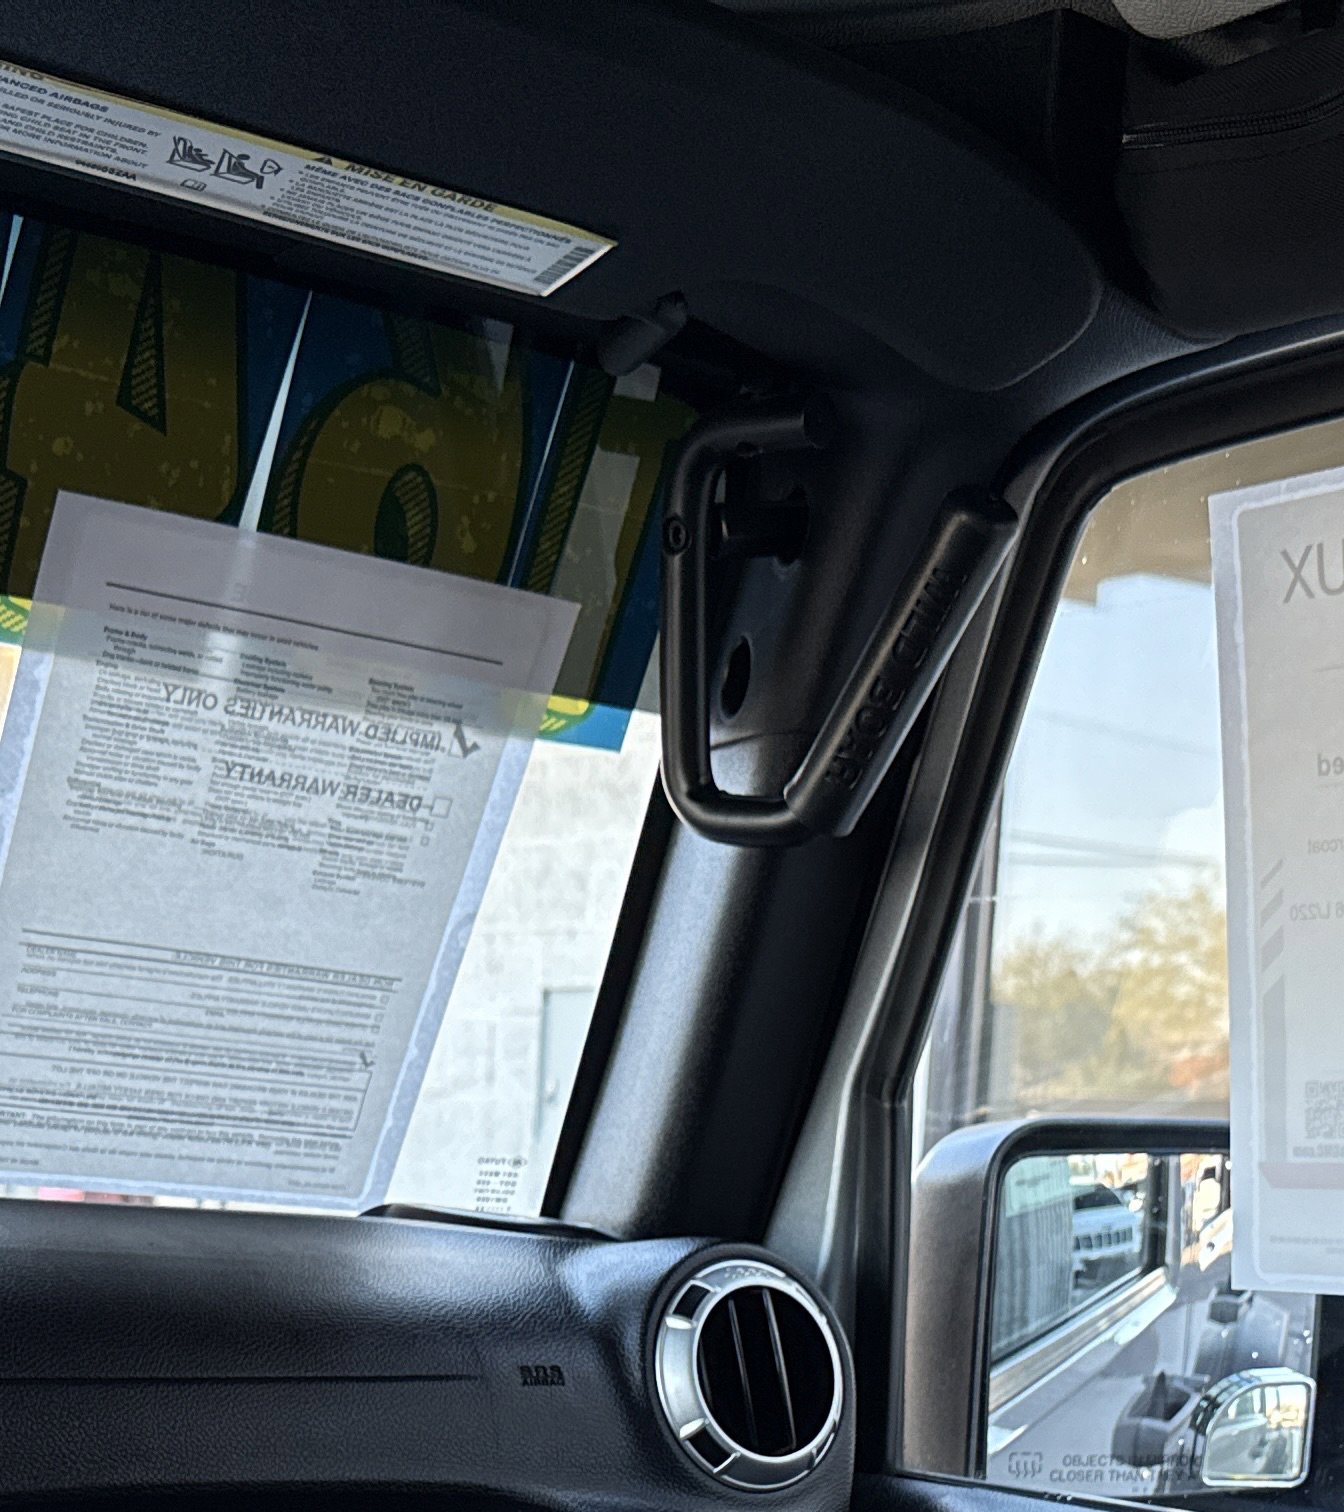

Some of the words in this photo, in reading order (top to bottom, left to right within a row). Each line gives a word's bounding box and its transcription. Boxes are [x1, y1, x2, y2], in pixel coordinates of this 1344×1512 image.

[48, 89, 108, 114] AIRBAGS
[344, 162, 393, 184] MISE
[396, 176, 426, 194] EN
[429, 186, 494, 213] GARDE
[1049, 1470, 1103, 1481] CLOSER
